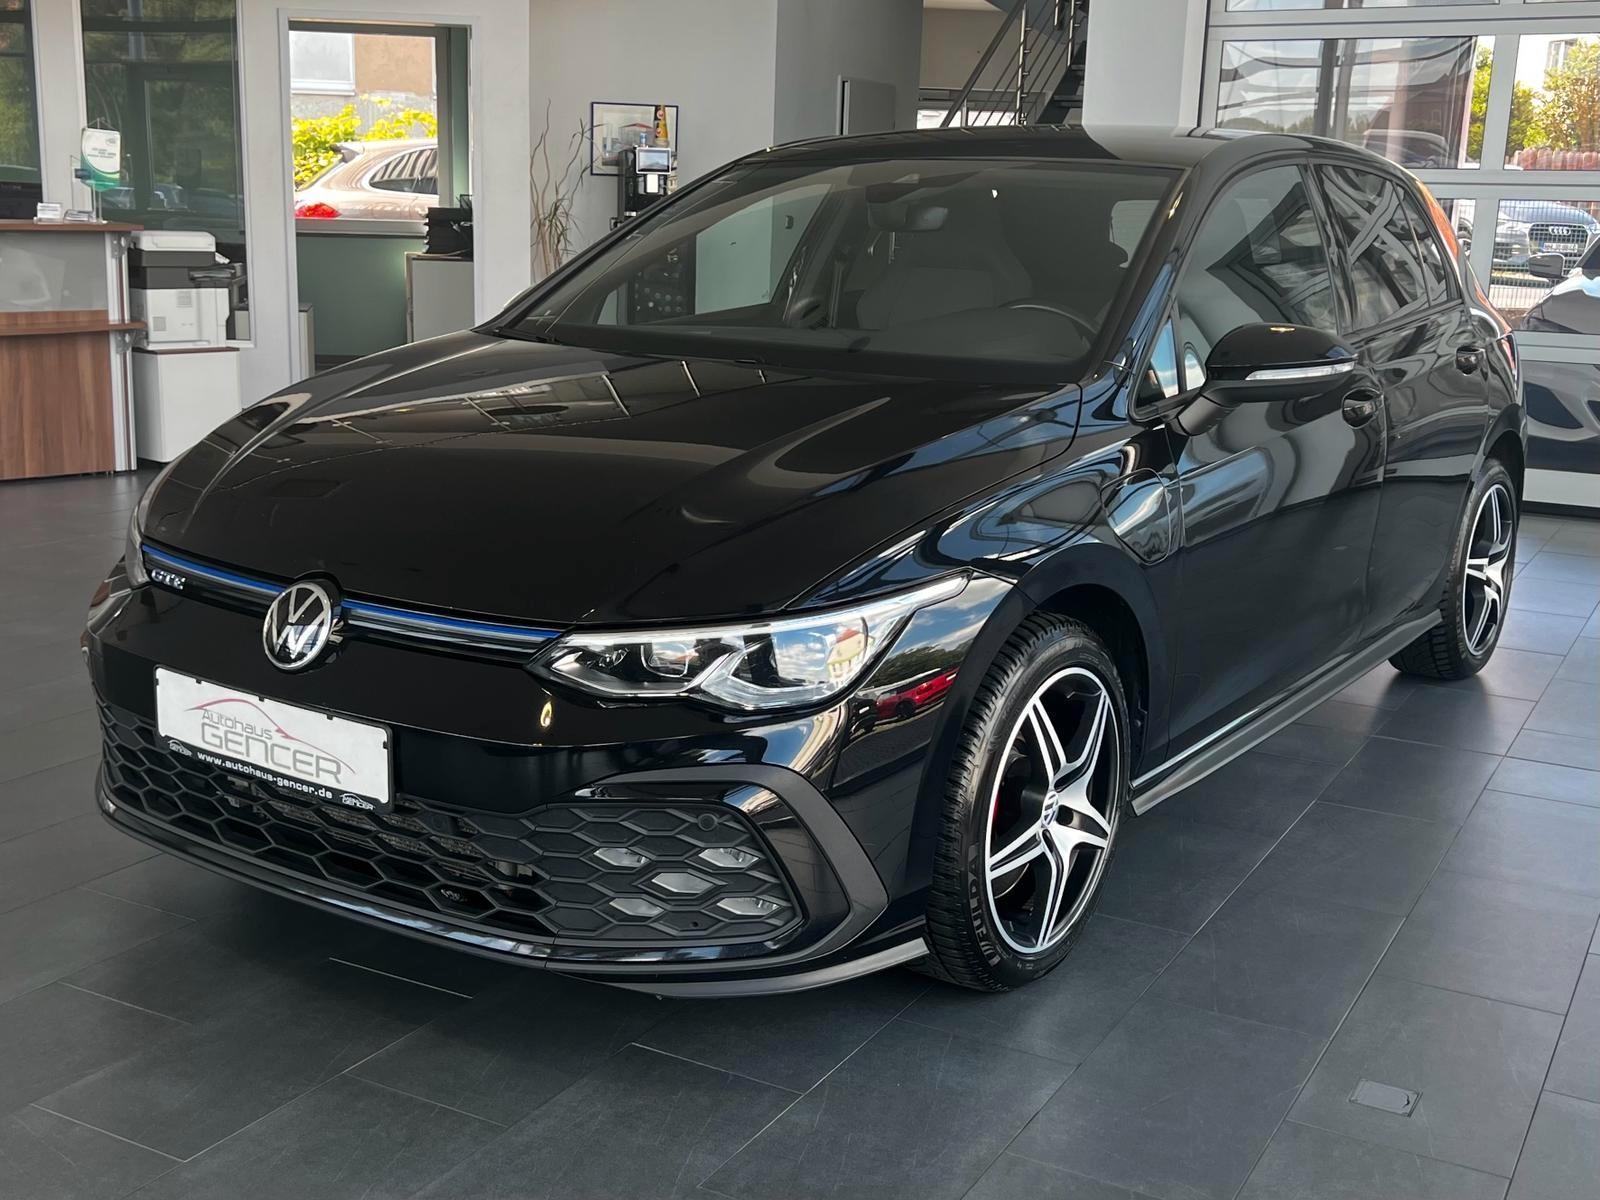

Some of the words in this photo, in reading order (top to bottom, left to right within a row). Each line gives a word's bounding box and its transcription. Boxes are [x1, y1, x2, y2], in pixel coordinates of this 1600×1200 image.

[201, 708, 273, 740] Autohaus
[197, 751, 333, 799] www.autohaus-gencer.de
[200, 721, 342, 785] GENCER
